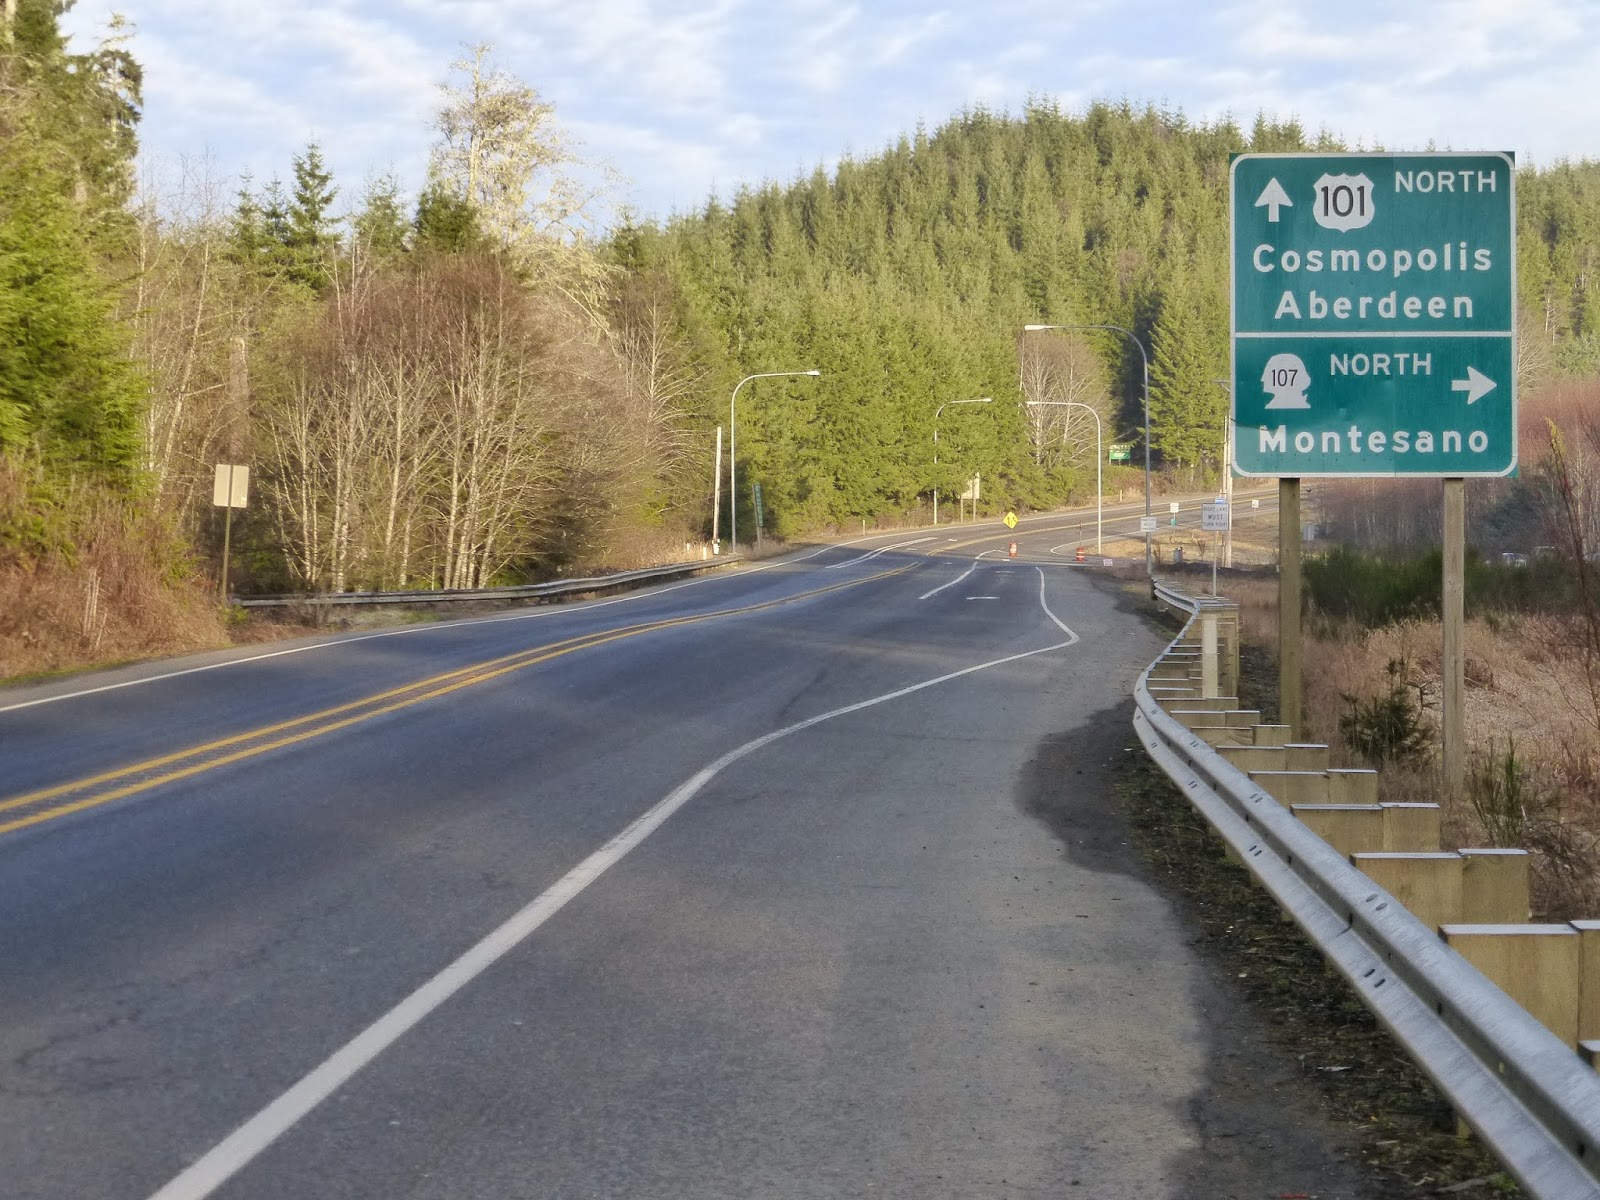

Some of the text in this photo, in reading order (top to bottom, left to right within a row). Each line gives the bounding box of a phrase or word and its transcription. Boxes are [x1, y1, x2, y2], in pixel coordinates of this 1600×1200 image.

[1394, 170, 1497, 193] NORTH
[1320, 185, 1366, 217] 101
[1253, 241, 1492, 278] Cosmopolis
[1274, 290, 1473, 319] Aberdeen
[1271, 369, 1299, 387] 107
[1330, 353, 1432, 376] NORTH
[1259, 425, 1489, 453] Montesano
